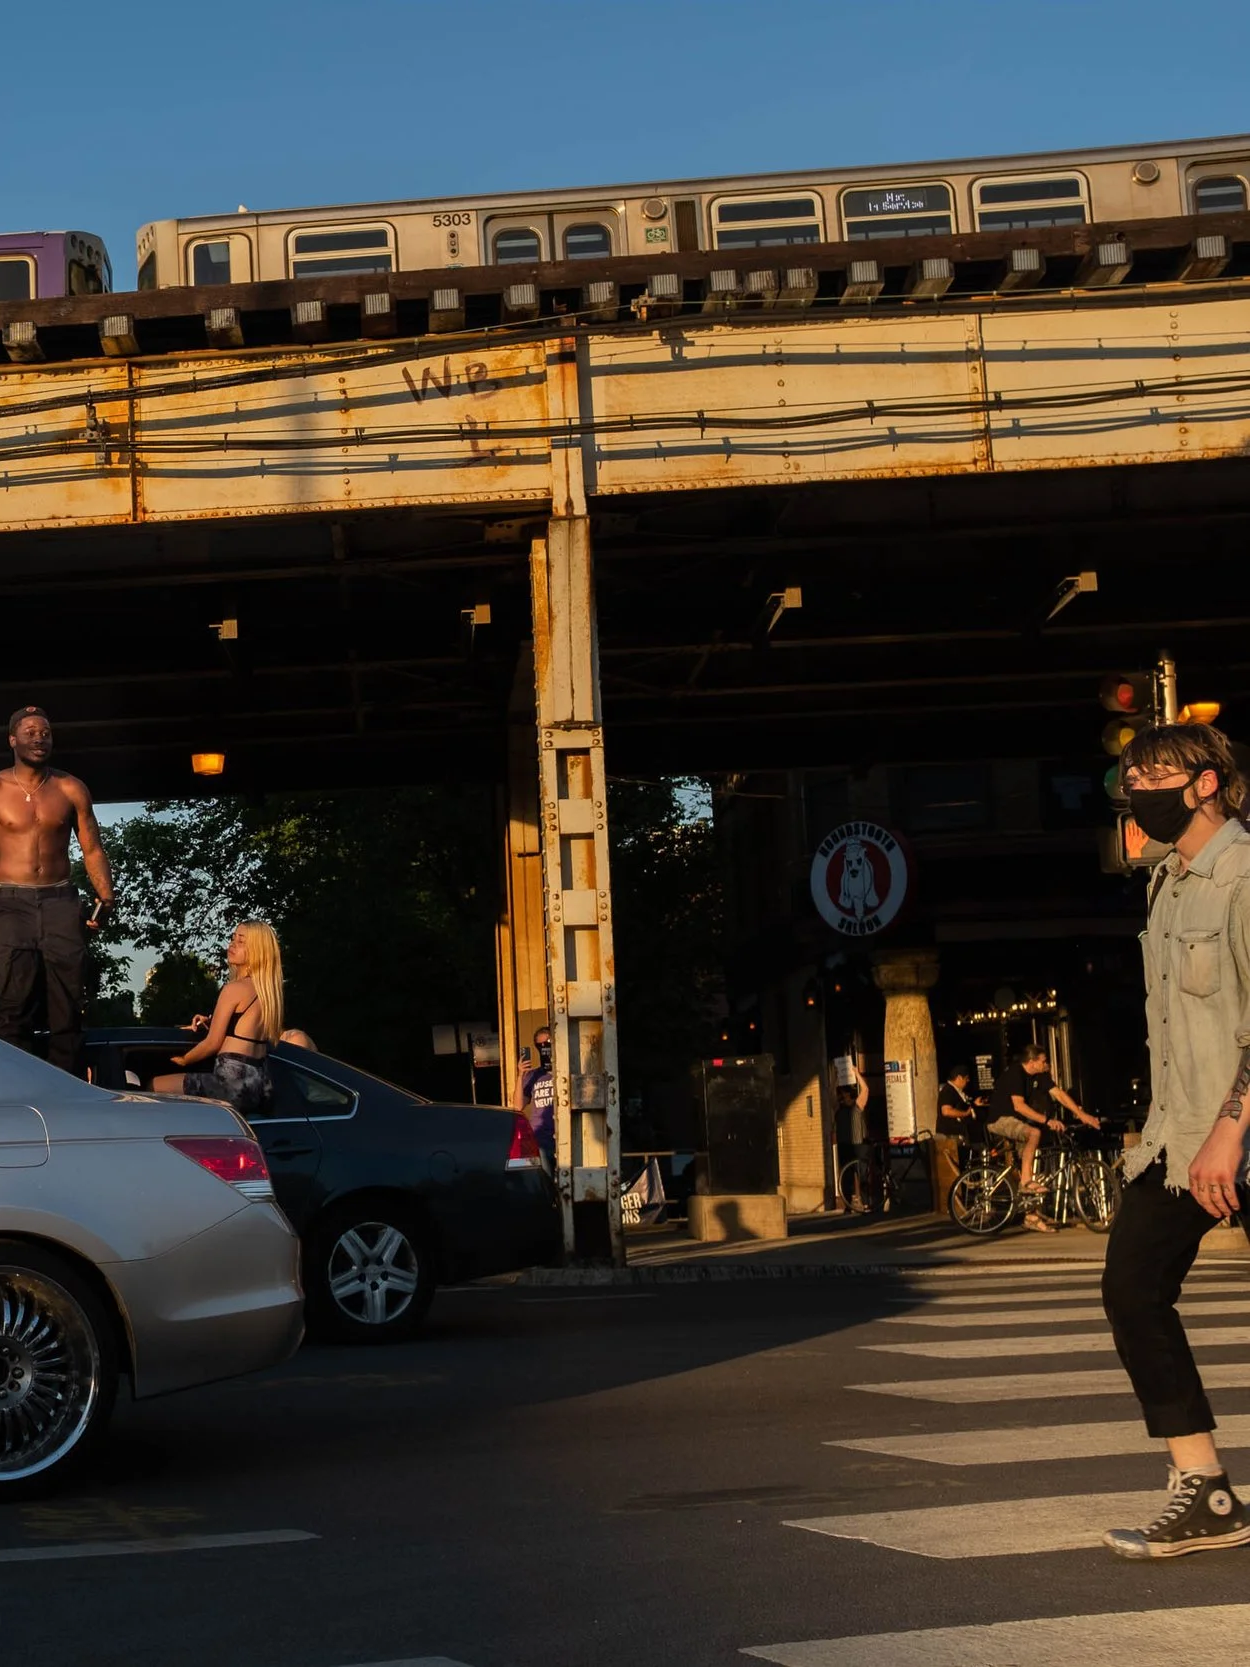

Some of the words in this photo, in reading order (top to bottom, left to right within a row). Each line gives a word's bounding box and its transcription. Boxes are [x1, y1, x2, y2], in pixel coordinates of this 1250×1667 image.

[432, 213, 471, 228] 5303
[818, 822, 897, 858] HOUNDSTOOTH
[837, 915, 882, 935] SALOON
[533, 1080, 554, 1090] MUSE
[534, 1088, 550, 1099] ARE
[534, 1097, 553, 1108] NEUT
[620, 1192, 642, 1210] GER
